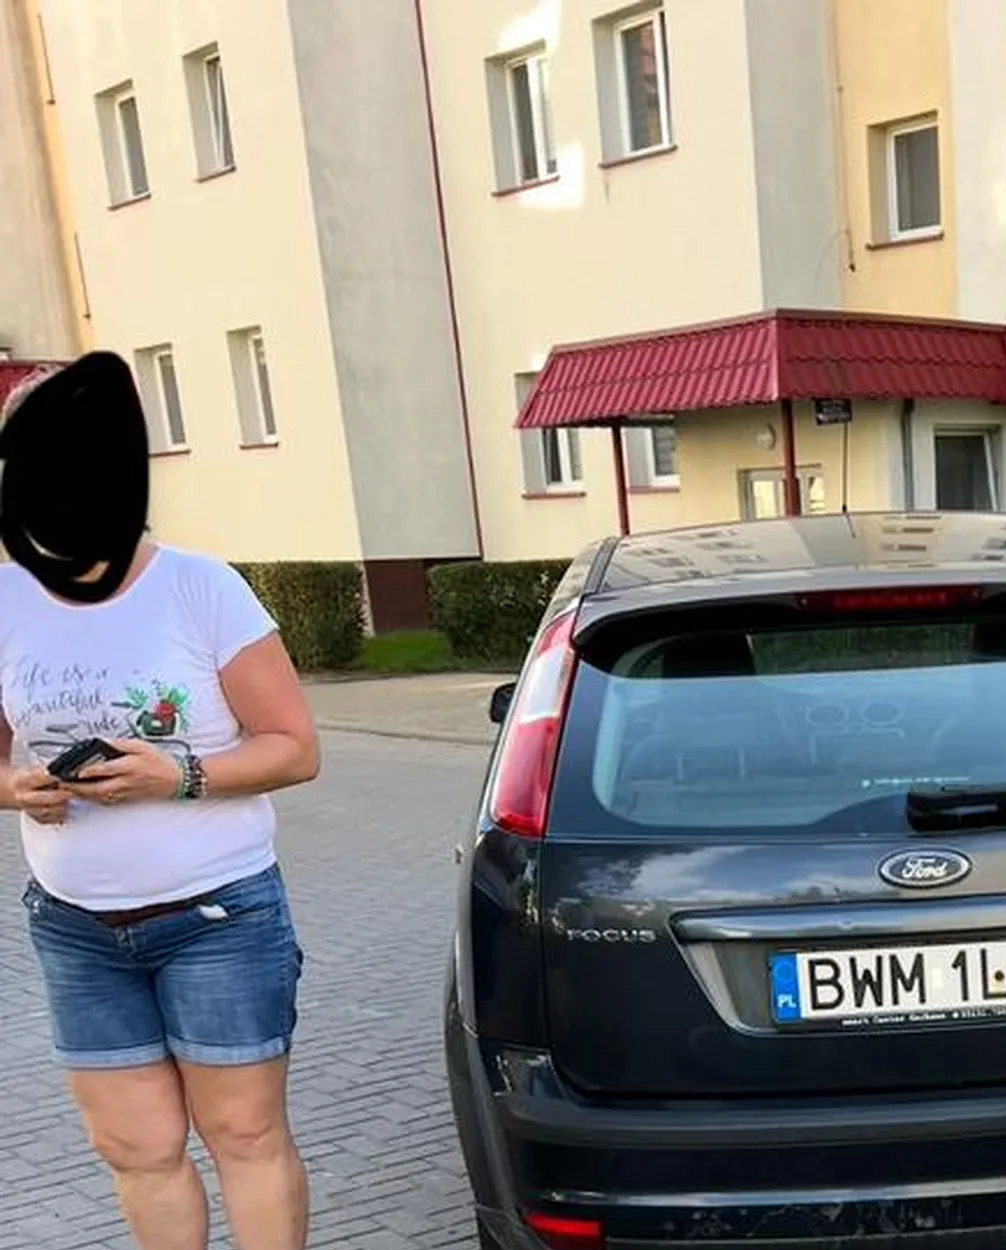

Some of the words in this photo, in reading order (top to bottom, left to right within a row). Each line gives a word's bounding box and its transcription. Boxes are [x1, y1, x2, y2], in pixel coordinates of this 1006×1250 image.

[901, 856, 949, 879] Ford
[566, 928, 656, 942] FOCUS
[807, 952, 928, 1011] BWM
[777, 993, 797, 1009] PL
